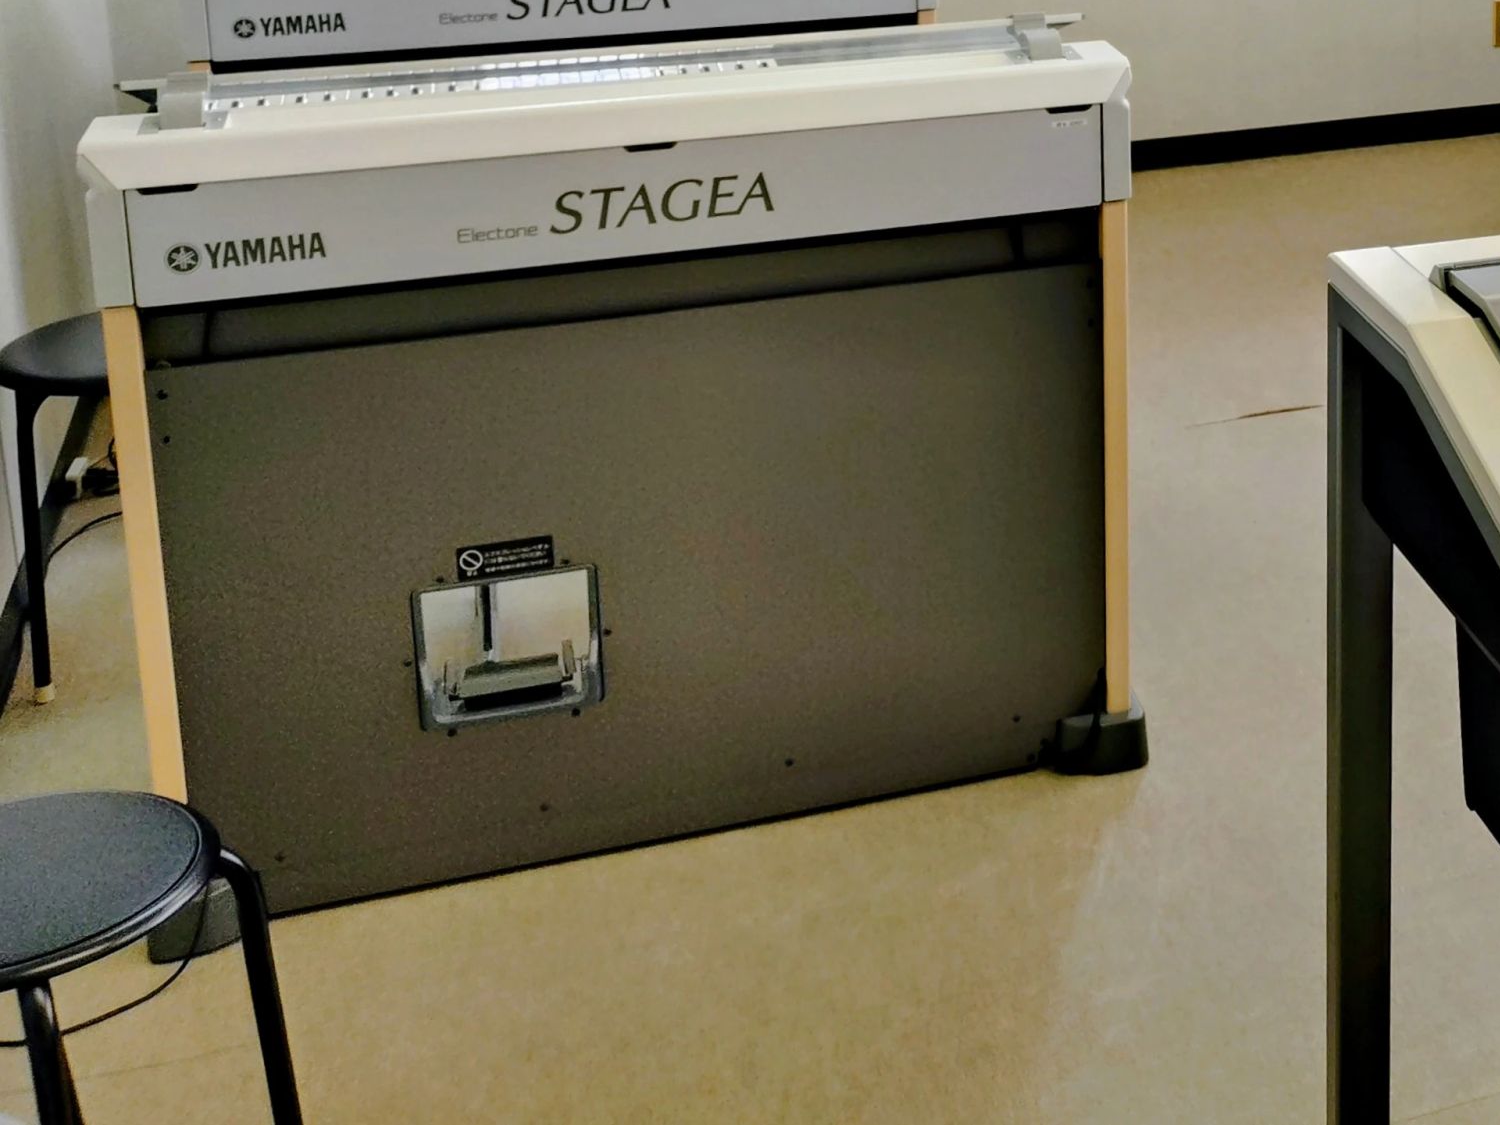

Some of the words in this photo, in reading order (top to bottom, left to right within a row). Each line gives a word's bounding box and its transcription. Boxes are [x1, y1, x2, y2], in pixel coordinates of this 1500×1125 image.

[260, 12, 346, 37] YAMAHA
[439, 12, 498, 25] Electone
[456, 225, 538, 244] Electone
[550, 172, 775, 234] STAGEA
[204, 232, 327, 269] YAMAHA
